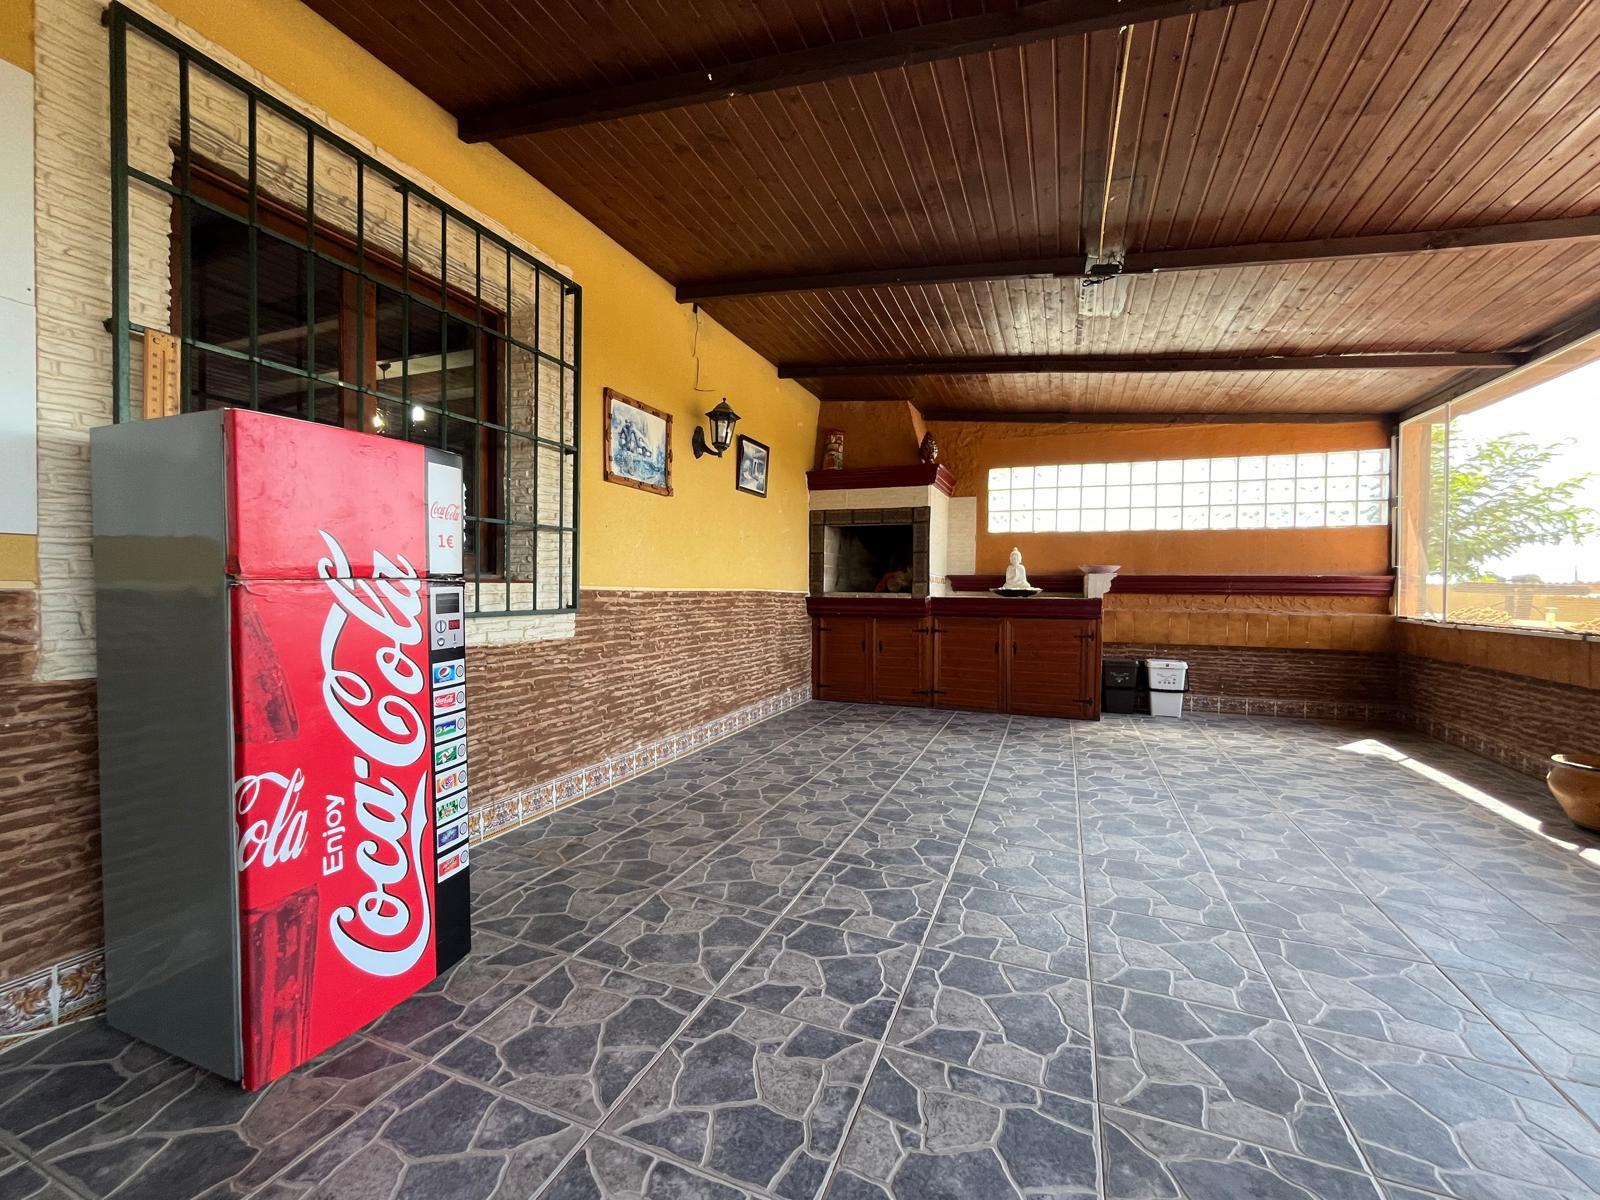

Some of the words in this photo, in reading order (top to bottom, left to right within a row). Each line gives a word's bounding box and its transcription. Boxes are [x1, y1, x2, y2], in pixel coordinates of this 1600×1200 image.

[438, 534, 454, 548] 1€
[317, 529, 432, 977] Coca-Cola
[322, 794, 345, 876] Enjoy
